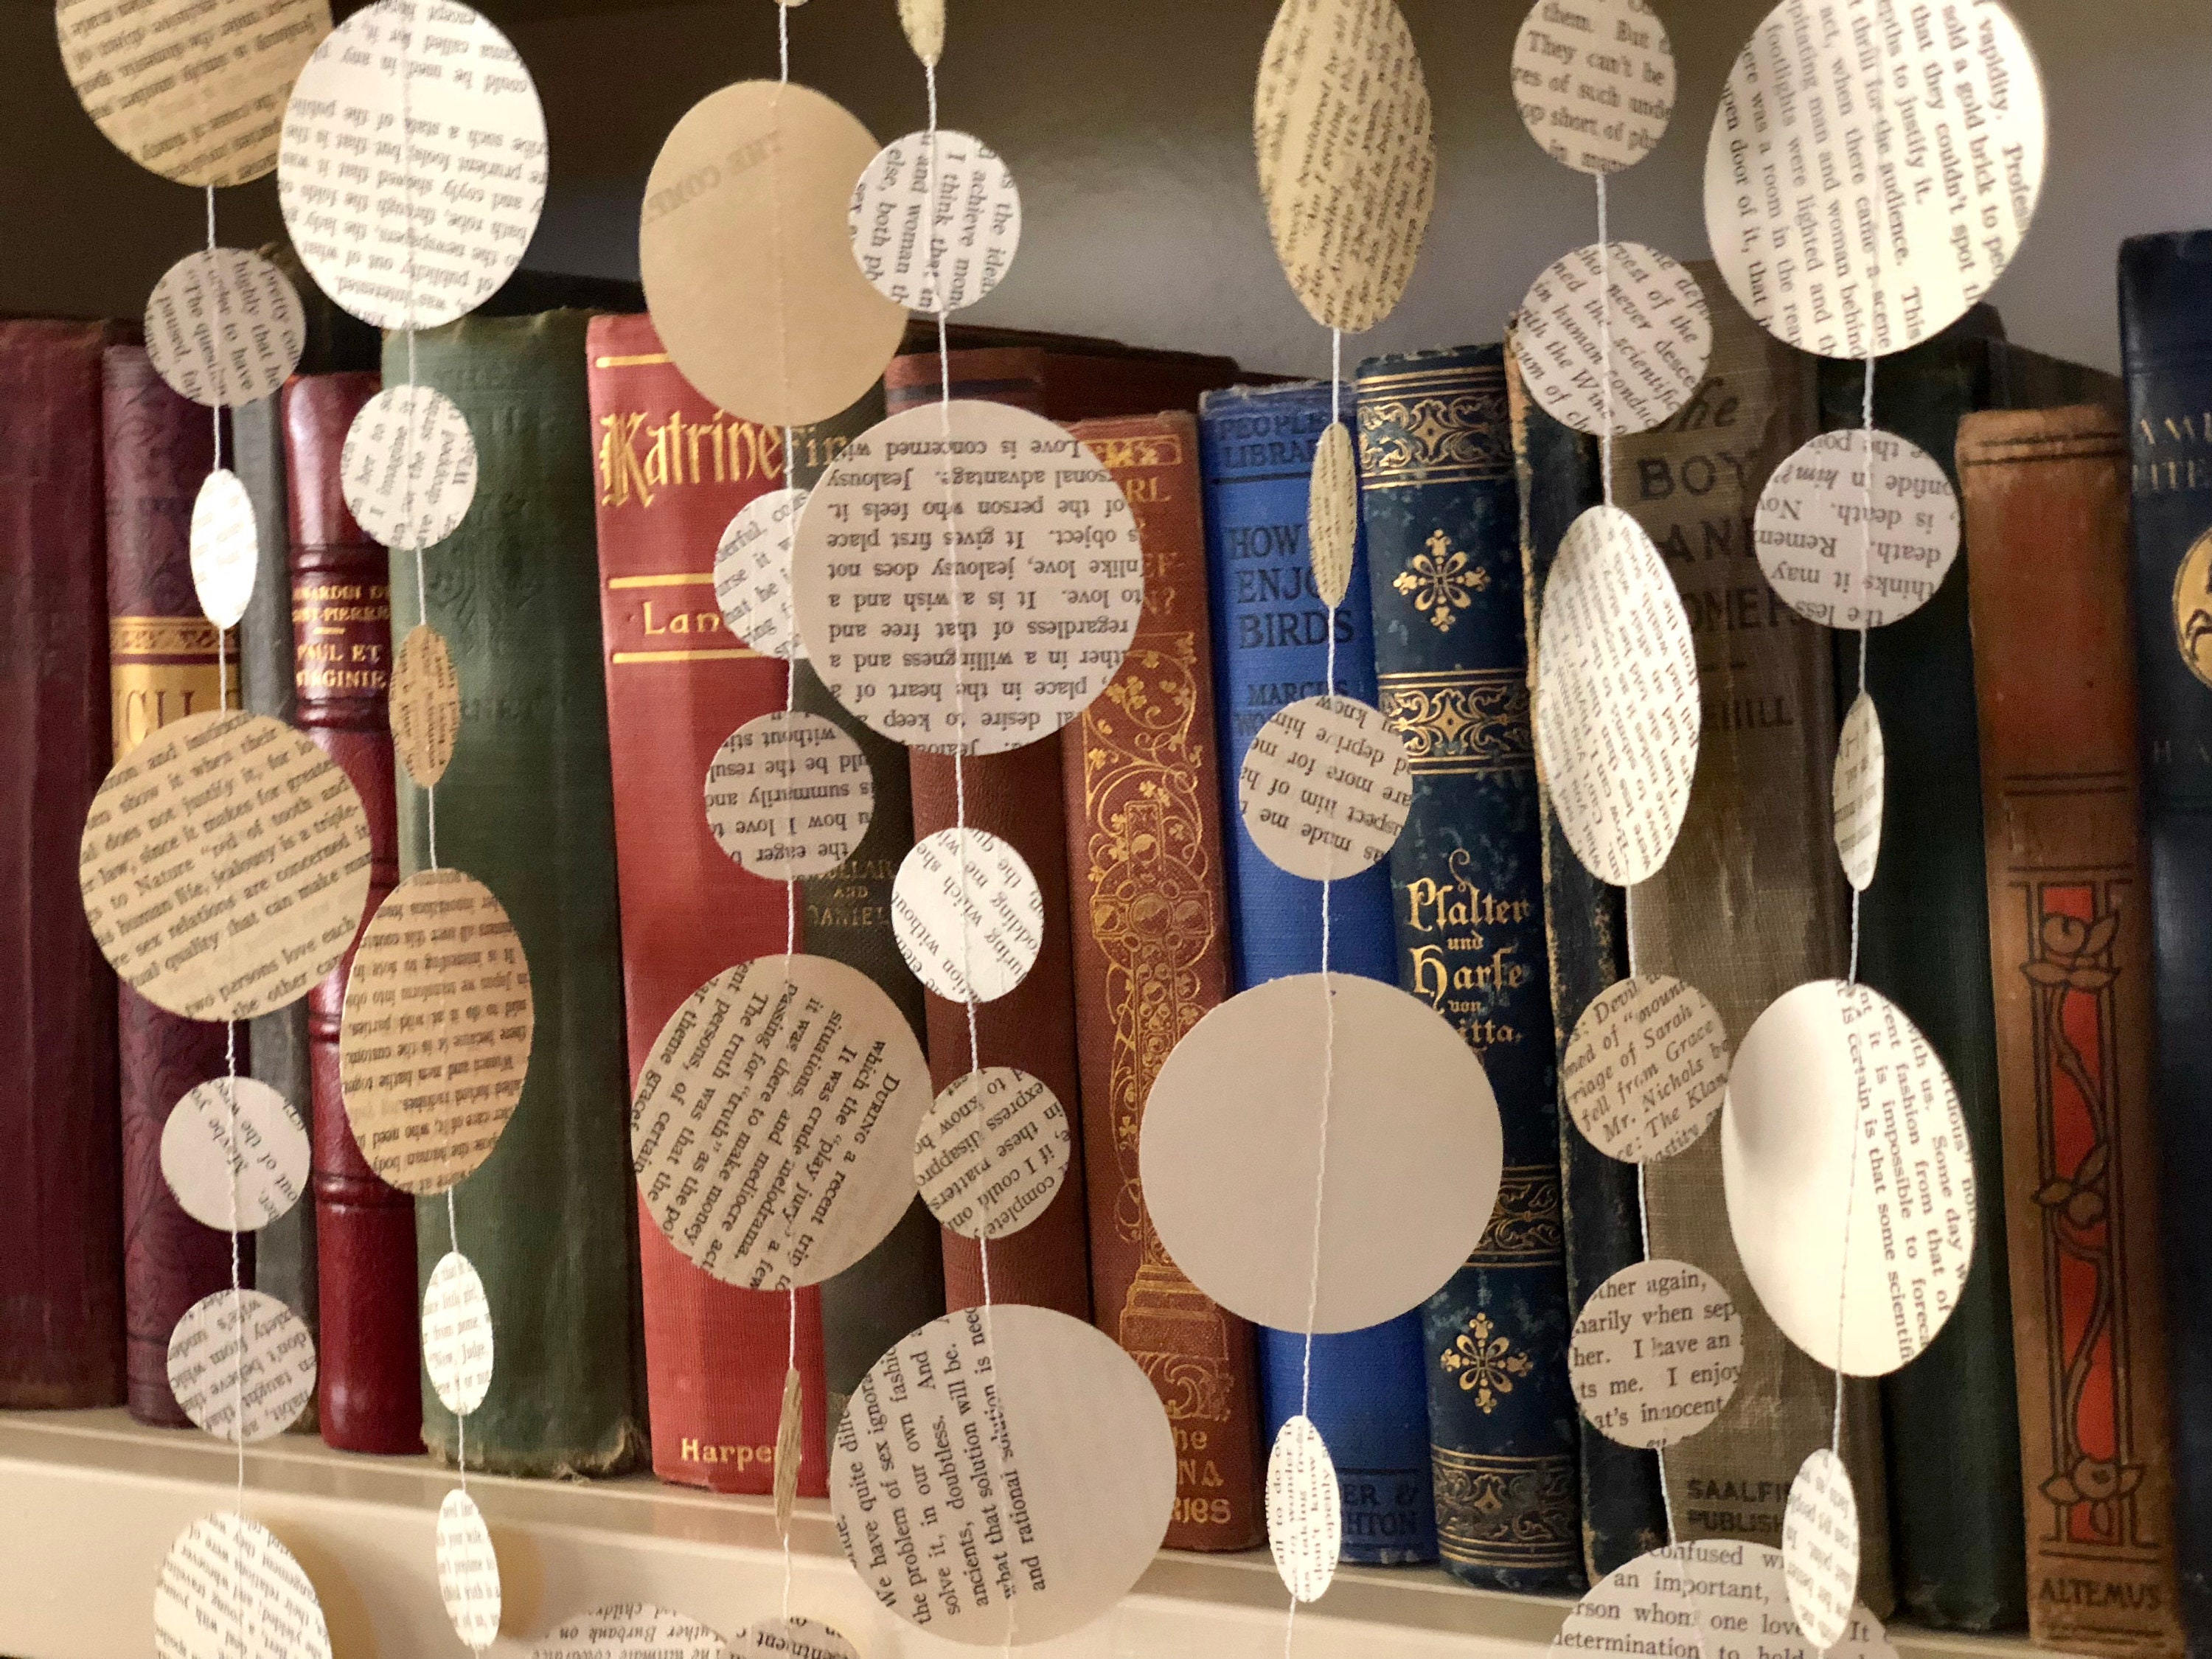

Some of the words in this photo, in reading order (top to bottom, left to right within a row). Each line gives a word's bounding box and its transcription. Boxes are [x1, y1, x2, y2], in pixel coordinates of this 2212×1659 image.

[877, 145, 906, 192] else,
[947, 153, 966, 161] I
[909, 155, 930, 194] and
[933, 173, 961, 226] think
[958, 170, 988, 247] achieve
[871, 201, 897, 247] both
[1787, 137, 1806, 186] were
[1809, 282, 1832, 323] and
[895, 204, 921, 274] woman
[1606, 283, 1653, 330] never
[1647, 289, 1675, 310] of
[1669, 315, 1698, 343] the
[1531, 280, 1553, 303] in
[1551, 302, 1616, 365] human
[251, 324, 274, 359] that
[1663, 378, 1740, 431] he
[600, 411, 782, 507] Katrine
[886, 441, 987, 462] concerned
[1001, 440, 1016, 459] is
[1030, 439, 1081, 458] Love
[1222, 443, 1312, 469] LIBRA
[827, 467, 914, 492] Jealousy
[827, 504, 849, 522] it.
[863, 502, 908, 521] feels
[978, 495, 1043, 514] person
[1058, 500, 1090, 518] the
[1105, 498, 1125, 518] of
[1915, 512, 1933, 534] is
[827, 528, 880, 552] place
[891, 532, 931, 551] first
[1006, 531, 1024, 549] It
[1048, 526, 1116, 549] object.
[1228, 524, 1303, 560] HOW
[827, 563, 861, 580] not
[873, 563, 919, 582] does
[1028, 557, 1076, 579] love,
[1771, 560, 1820, 583] may
[1833, 571, 1850, 593] it
[1865, 575, 1935, 604] thinks
[644, 602, 720, 635] Lan
[936, 622, 977, 641] that
[993, 622, 1014, 641] of
[1027, 616, 1128, 639] regardless
[1239, 611, 1354, 648] BIRDS
[829, 624, 866, 643] and
[881, 623, 919, 642] free
[352, 644, 382, 664] ET
[762, 727, 837, 749] without
[765, 759, 796, 778] the
[805, 757, 829, 774] be
[1286, 751, 1316, 776] for
[1267, 778, 1290, 796] of
[1326, 766, 1374, 793] more
[736, 818, 775, 838] love
[808, 813, 847, 832] how
[1259, 808, 1289, 829] me
[818, 842, 851, 861] the
[997, 861, 1022, 888] the
[942, 877, 982, 927] which
[882, 893, 939, 954] without
[1447, 930, 1484, 950] und
[740, 992, 769, 1027] The
[1618, 1041, 1638, 1068] of
[1643, 1004, 1694, 1049] Sarah
[712, 1033, 745, 1079] truth
[838, 1046, 858, 1063] It
[852, 1040, 886, 1091] which
[818, 1071, 842, 1102] was
[987, 1077, 1006, 1095] to
[690, 1088, 716, 1120] was
[835, 1096, 858, 1126] the
[1602, 1113, 1636, 1142] Mr.
[1641, 1057, 1705, 1113] Nichols
[1580, 1095, 1611, 1132] fell
[1645, 1107, 1680, 1138] The
[240, 1121, 262, 1148] the
[792, 1106, 822, 1156] crude
[996, 1121, 1039, 1158] these
[667, 1127, 695, 1165] that
[843, 1150, 856, 1163] a
[1037, 1144, 1055, 1165] if
[257, 1152, 277, 1170] of
[1023, 1157, 1037, 1175] I
[274, 1175, 302, 1202] out
[647, 1171, 672, 1202] the
[810, 1171, 846, 1225] recent
[1895, 1063, 1920, 1145] fashion
[1914, 1160, 1933, 1215] from
[1926, 1229, 1945, 1276] that
[1937, 1290, 1955, 1314] of
[943, 1343, 961, 1374] be.
[1633, 1339, 1644, 1358] I
[1706, 1334, 1731, 1350] an
[910, 1351, 936, 1390] And
[1610, 1377, 1643, 1395] me.
[1667, 1367, 1677, 1386] I
[947, 1380, 972, 1415] will
[681, 1437, 776, 1472] Harpe
[876, 1441, 894, 1471] sex
[931, 1416, 965, 1510] doubtless.
[962, 1422, 993, 1498] solution
[880, 1479, 901, 1499] of
[1273, 1470, 1281, 1494] do
[1687, 1477, 1792, 1503] SAALFI
[981, 1505, 1004, 1545] that
[1276, 1507, 1282, 1526] to
[891, 1506, 927, 1587] problem
[1276, 1541, 1284, 1564] all
[958, 1521, 990, 1607] ancients,
[1613, 1569, 1639, 1588] an
[2038, 1577, 2163, 1609] ALTEMUS
[912, 1593, 932, 1624] the
[560, 1627, 578, 1639] on
[588, 1621, 656, 1645] Burbank
[1711, 1615, 1747, 1631] one
